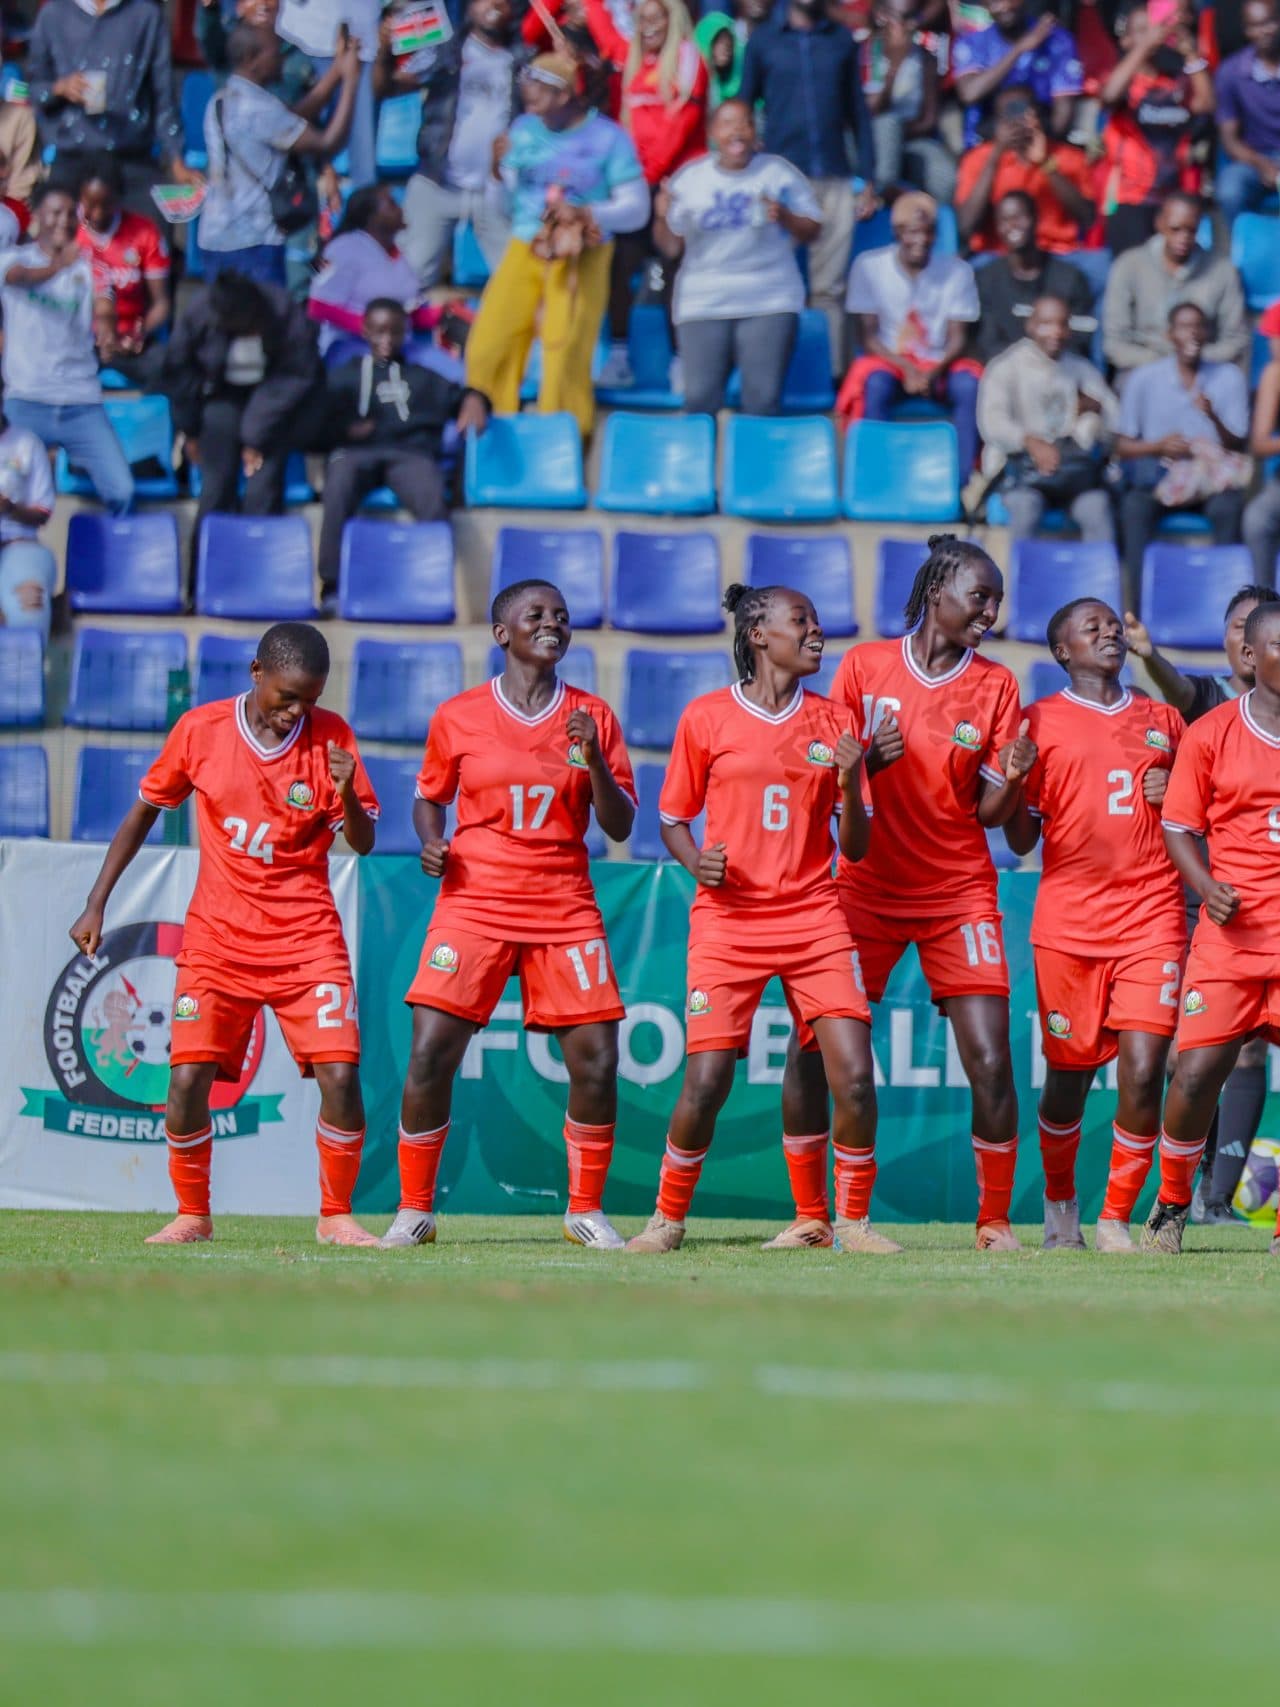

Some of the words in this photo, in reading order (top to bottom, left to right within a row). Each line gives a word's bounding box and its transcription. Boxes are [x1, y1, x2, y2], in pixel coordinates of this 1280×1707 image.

[862, 694, 901, 740] 16
[509, 784, 555, 830] 17
[762, 784, 790, 831] 6
[1107, 769, 1134, 815] 2
[223, 816, 274, 865] 24
[566, 938, 608, 991] 17
[960, 921, 1001, 966] 16
[1159, 961, 1180, 1007] 2
[63, 954, 110, 1089] FOOTBALL
[67, 1109, 237, 1141] FEDERAN
